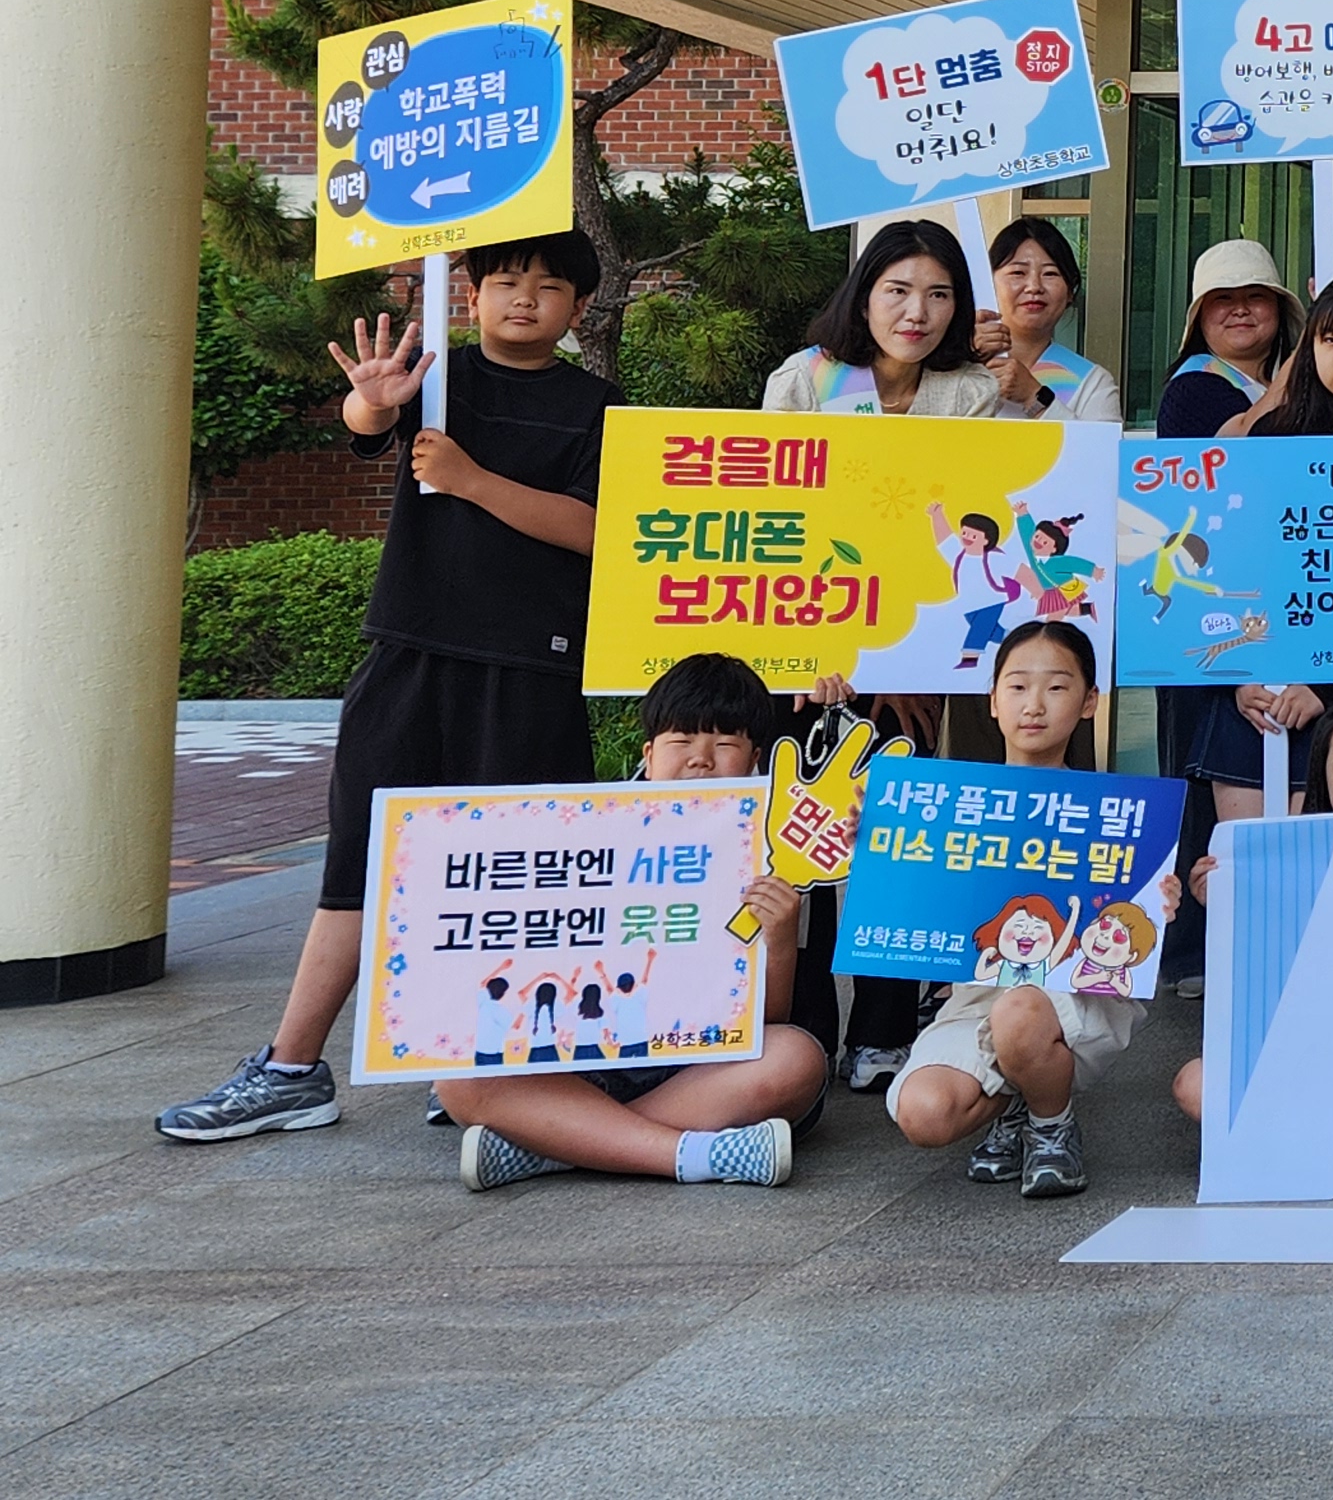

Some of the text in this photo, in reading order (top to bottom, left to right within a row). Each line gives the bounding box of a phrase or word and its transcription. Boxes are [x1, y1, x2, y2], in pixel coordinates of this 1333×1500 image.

[1254, 17, 1314, 53] 4고
[365, 41, 405, 77] 관심
[865, 48, 1003, 100] 1단 멈춤
[1026, 61, 1060, 73] STOP
[1235, 60, 1317, 82] 방어보행,
[399, 70, 506, 122] 학교폭력
[1258, 88, 1315, 113] 습관을
[325, 98, 363, 131] 사랑
[906, 100, 966, 131] 일단
[370, 105, 540, 170] 예방의 지름길
[997, 146, 1091, 177] 상학초등학교
[329, 171, 366, 206] 배려
[401, 227, 467, 253] 상학초등학교
[662, 435, 829, 489] 걸을때
[1133, 447, 1226, 493] STOP
[633, 508, 806, 564] 휴대폰
[654, 574, 880, 627] 보지않기
[751, 657, 819, 675] 학부모회
[877, 780, 1146, 839] 사랑 품고 가는 말!
[445, 844, 713, 891] 바른말엔 사랑
[869, 826, 1135, 885] 미소 담고 오는 말!
[433, 903, 702, 953] 고운말엔 웃음
[854, 925, 965, 952] 상학초등학교
[650, 1030, 744, 1050] 상학초등학교
